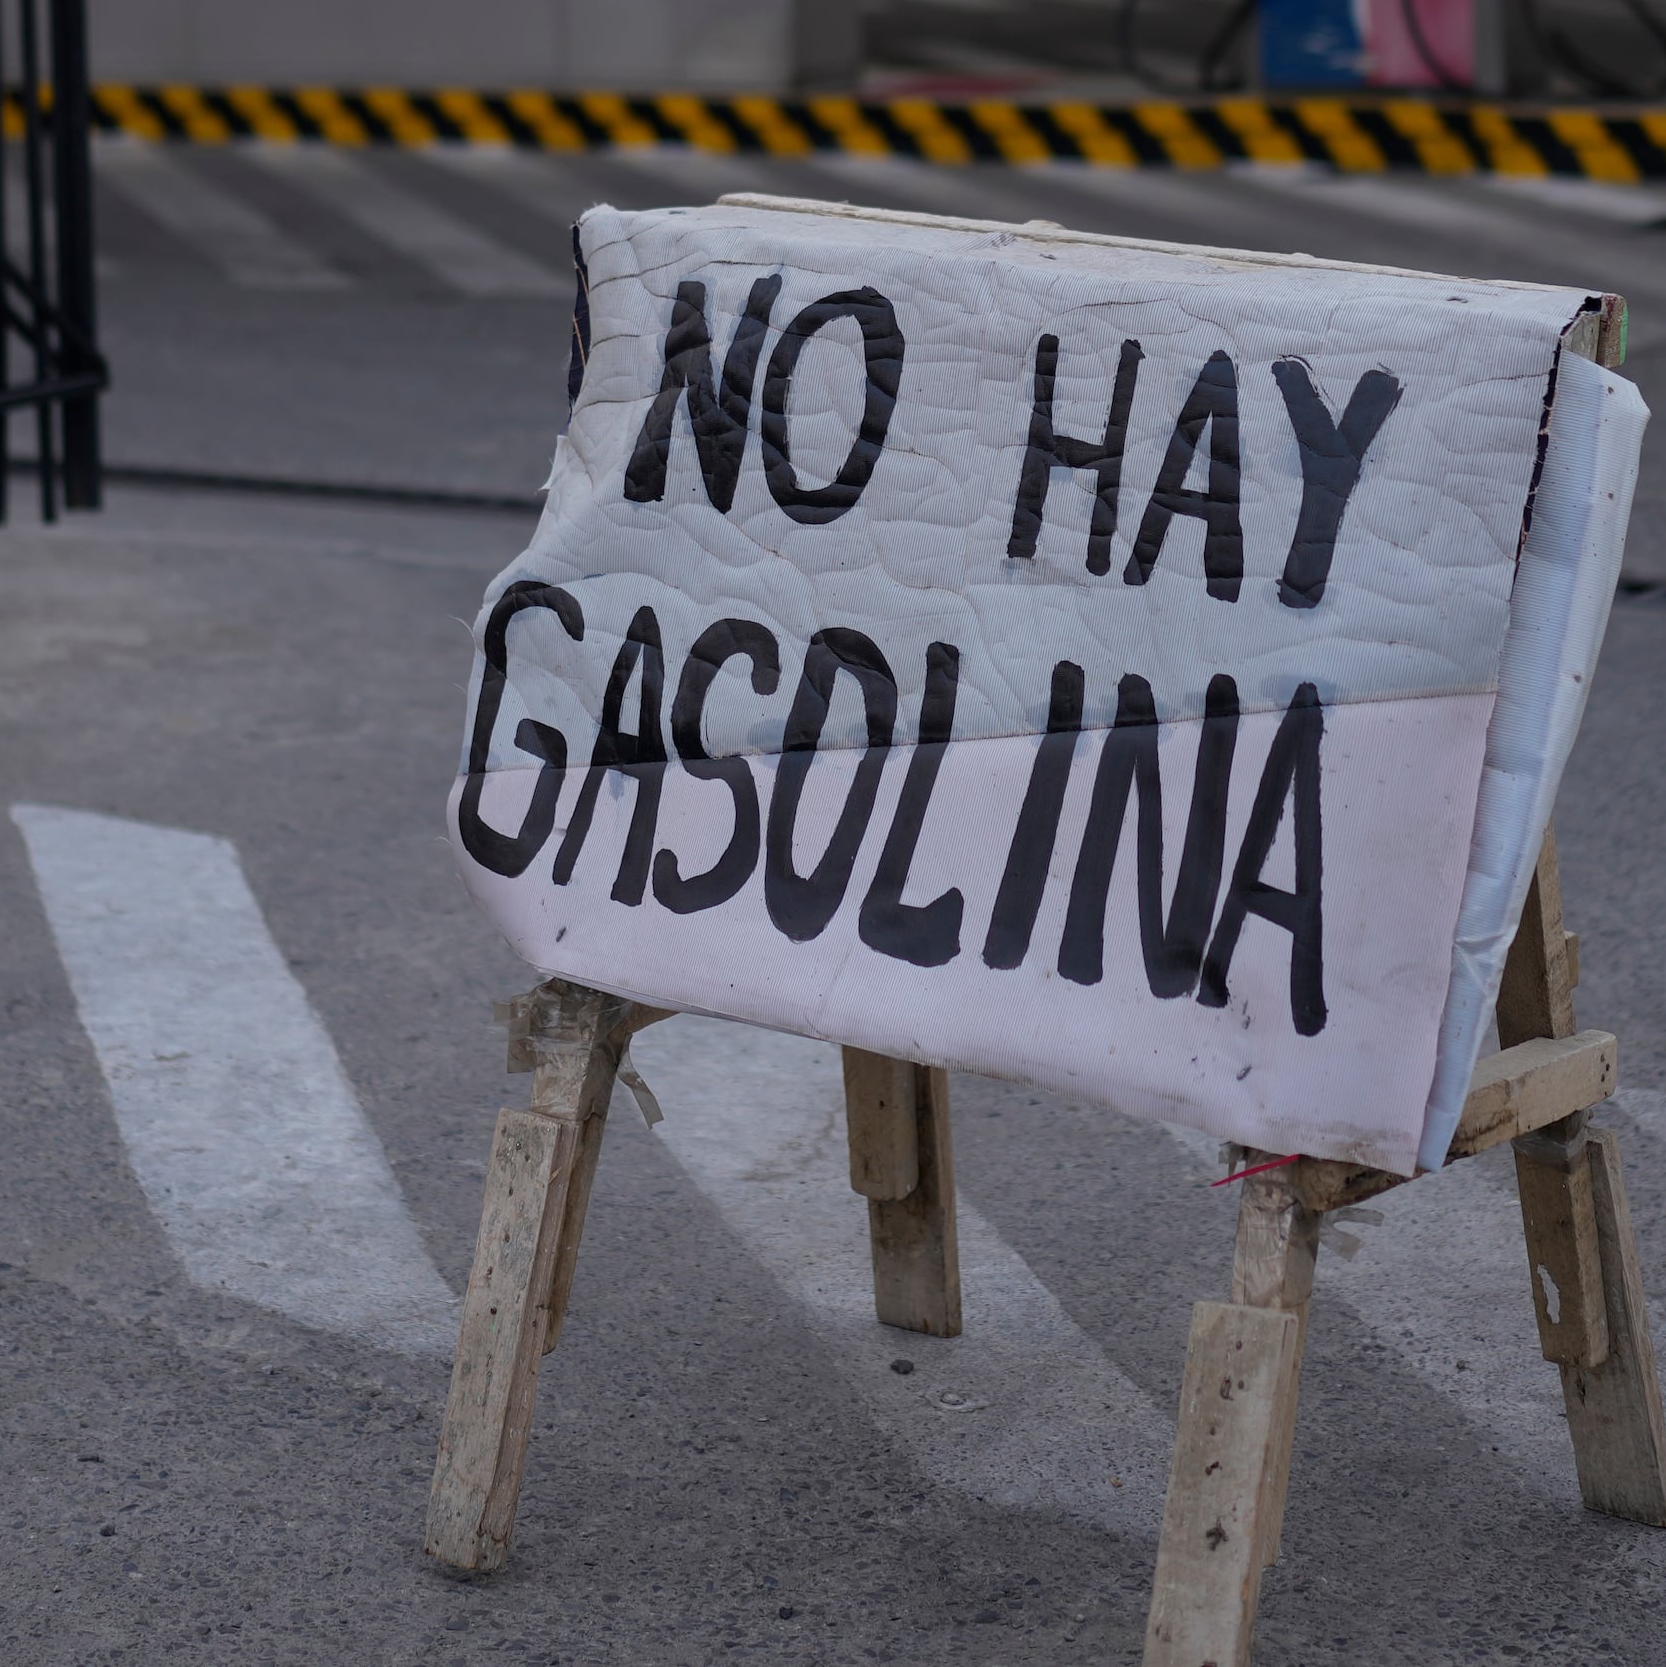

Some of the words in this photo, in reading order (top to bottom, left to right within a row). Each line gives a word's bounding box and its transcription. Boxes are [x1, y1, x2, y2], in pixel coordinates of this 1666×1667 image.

[622, 272, 906, 525] NO
[1006, 333, 1406, 609] HAY
[456, 578, 1329, 1039] GASOLINA
